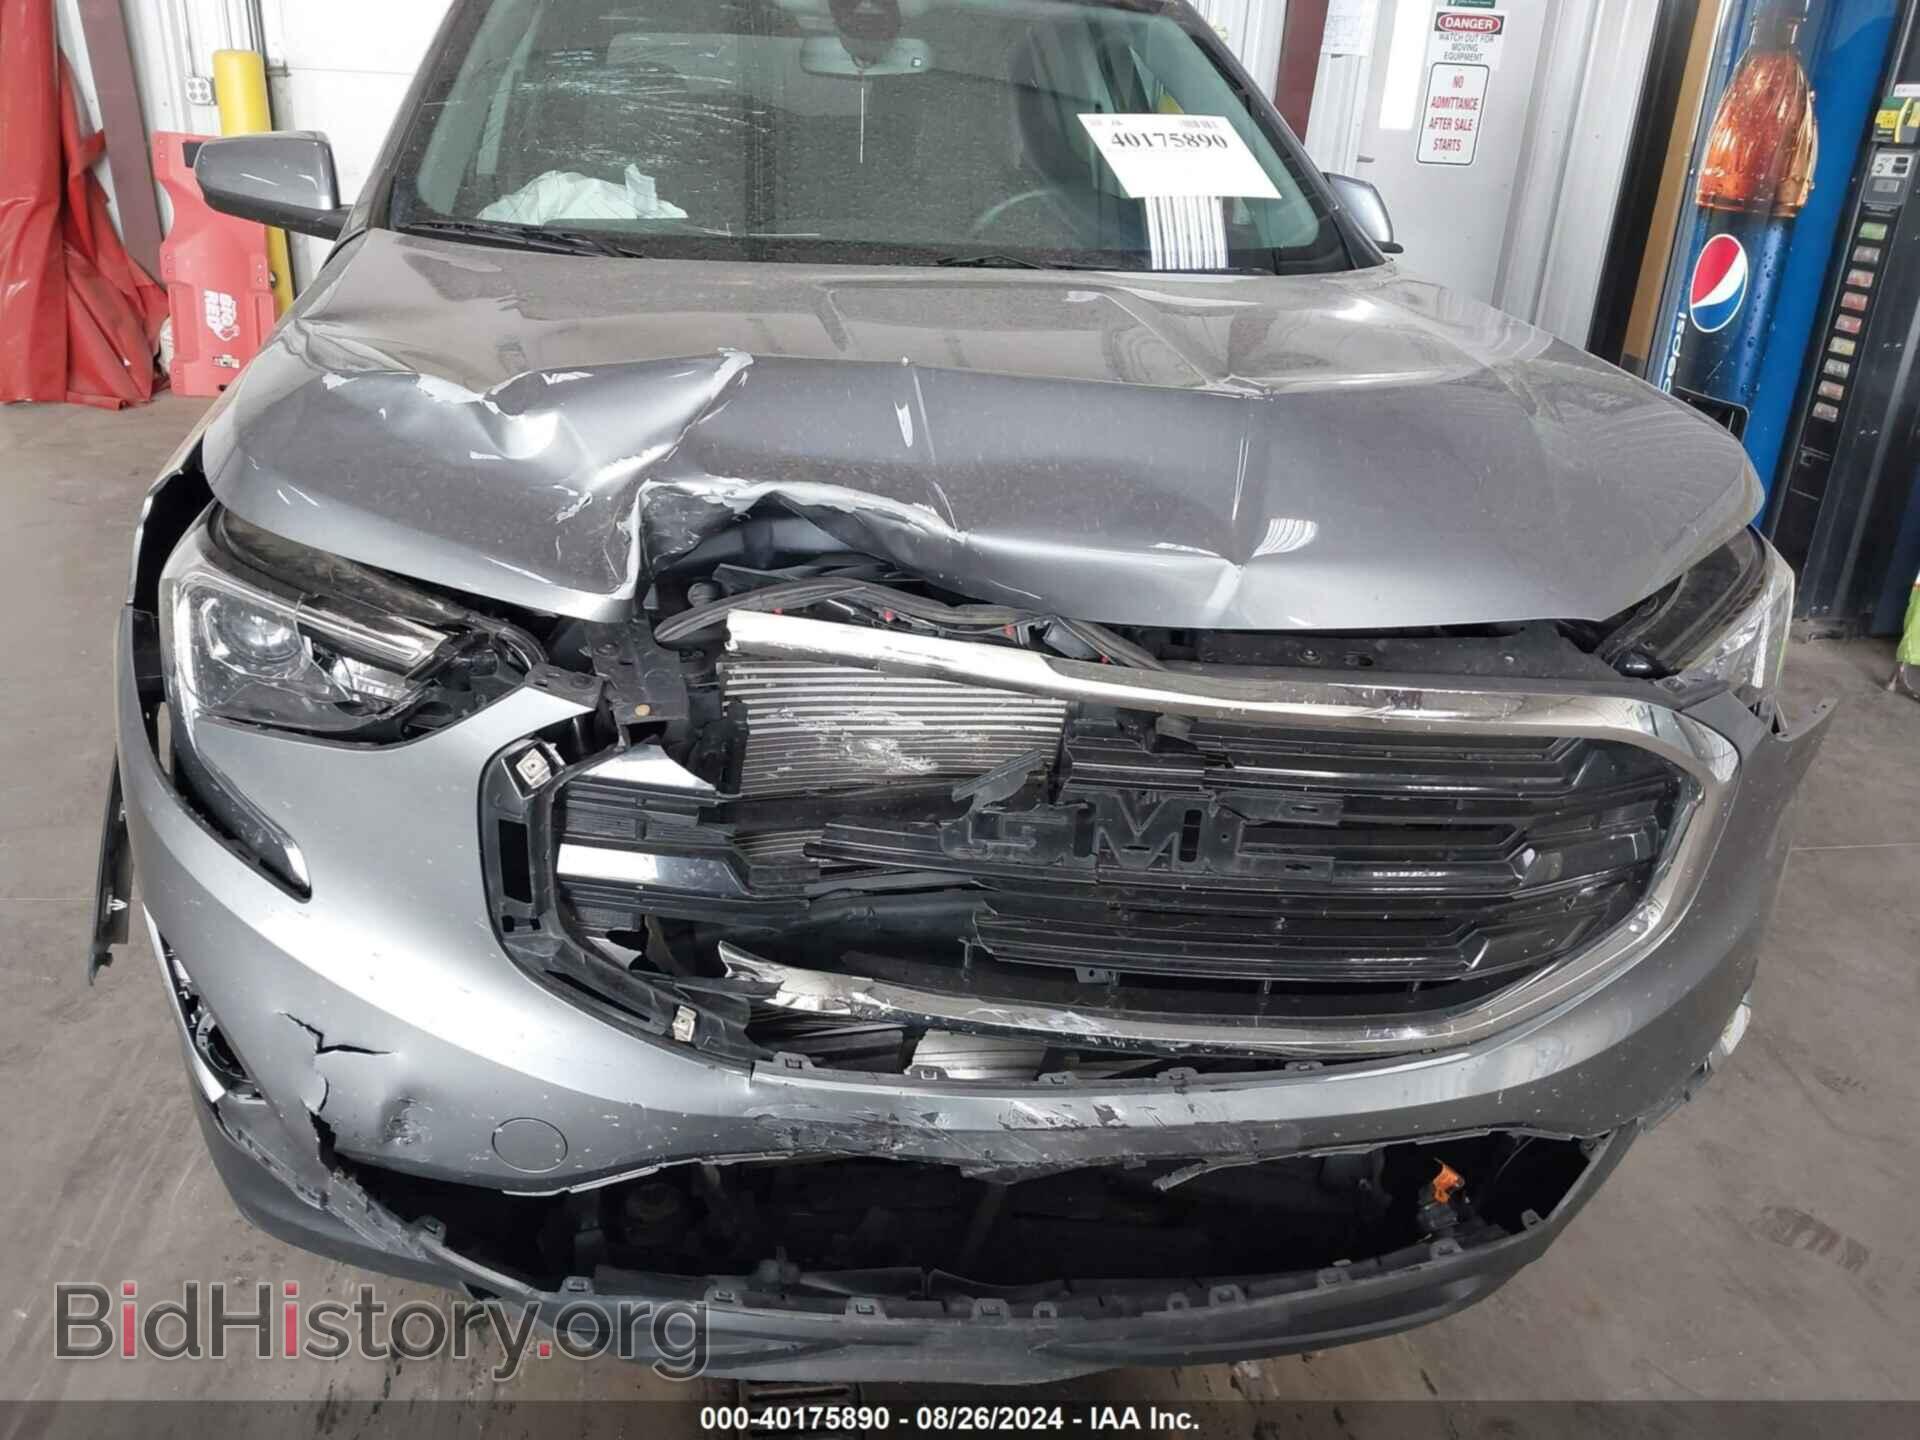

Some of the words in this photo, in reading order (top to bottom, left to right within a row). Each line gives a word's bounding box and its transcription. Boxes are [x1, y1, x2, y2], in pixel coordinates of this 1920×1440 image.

[1445, 16, 1494, 30] DANGER
[1438, 32, 1464, 42] WATCH
[1465, 33, 1479, 43] OUT
[1451, 43, 1478, 52] MOVING
[1443, 52, 1484, 62] EQUIPMENT
[1452, 75, 1465, 89] NO
[1430, 96, 1479, 111] ADMITTANCE
[1428, 116, 1453, 130] AFTER
[1454, 117, 1473, 132] SALE
[1111, 131, 1229, 150] 40175890
[1432, 137, 1462, 152] STARTS
[1662, 311, 1687, 394] pepsi
